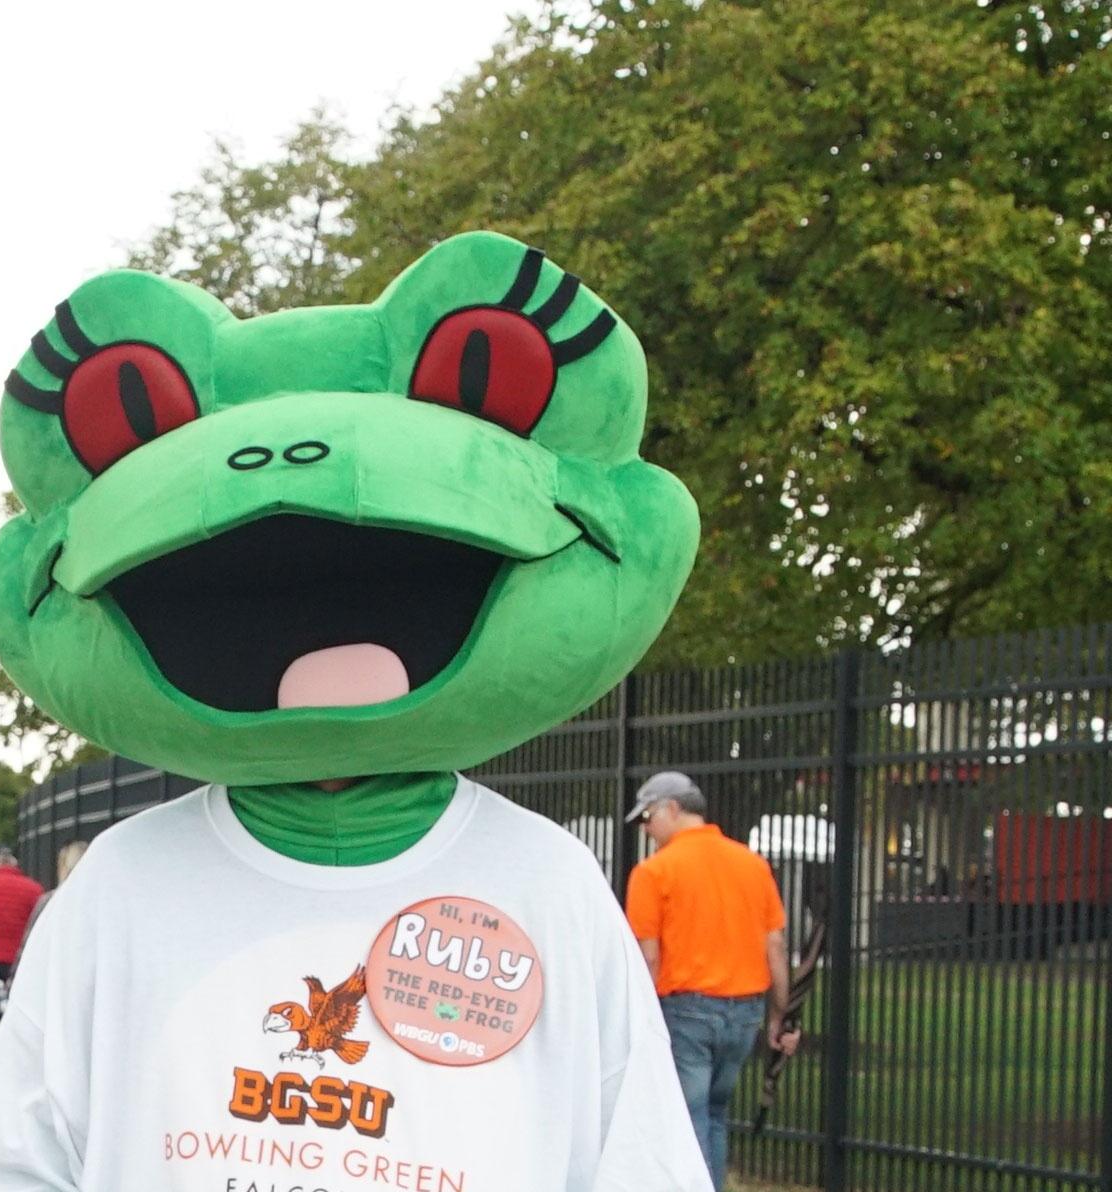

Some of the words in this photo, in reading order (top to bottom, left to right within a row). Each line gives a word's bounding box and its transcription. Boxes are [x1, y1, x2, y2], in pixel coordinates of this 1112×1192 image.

[440, 903, 463, 924] HI,
[471, 912, 500, 931] I'M
[389, 912, 535, 992] Ruby
[383, 986, 429, 1010] TREE
[465, 1009, 515, 1033] FROG
[387, 969, 423, 990] THE
[428, 979, 518, 1015] RED-EYED
[393, 1022, 440, 1044] WBGU
[459, 1038, 486, 1058] PBS
[229, 1067, 395, 1139] BGSU
[165, 1131, 325, 1170] BOWLING
